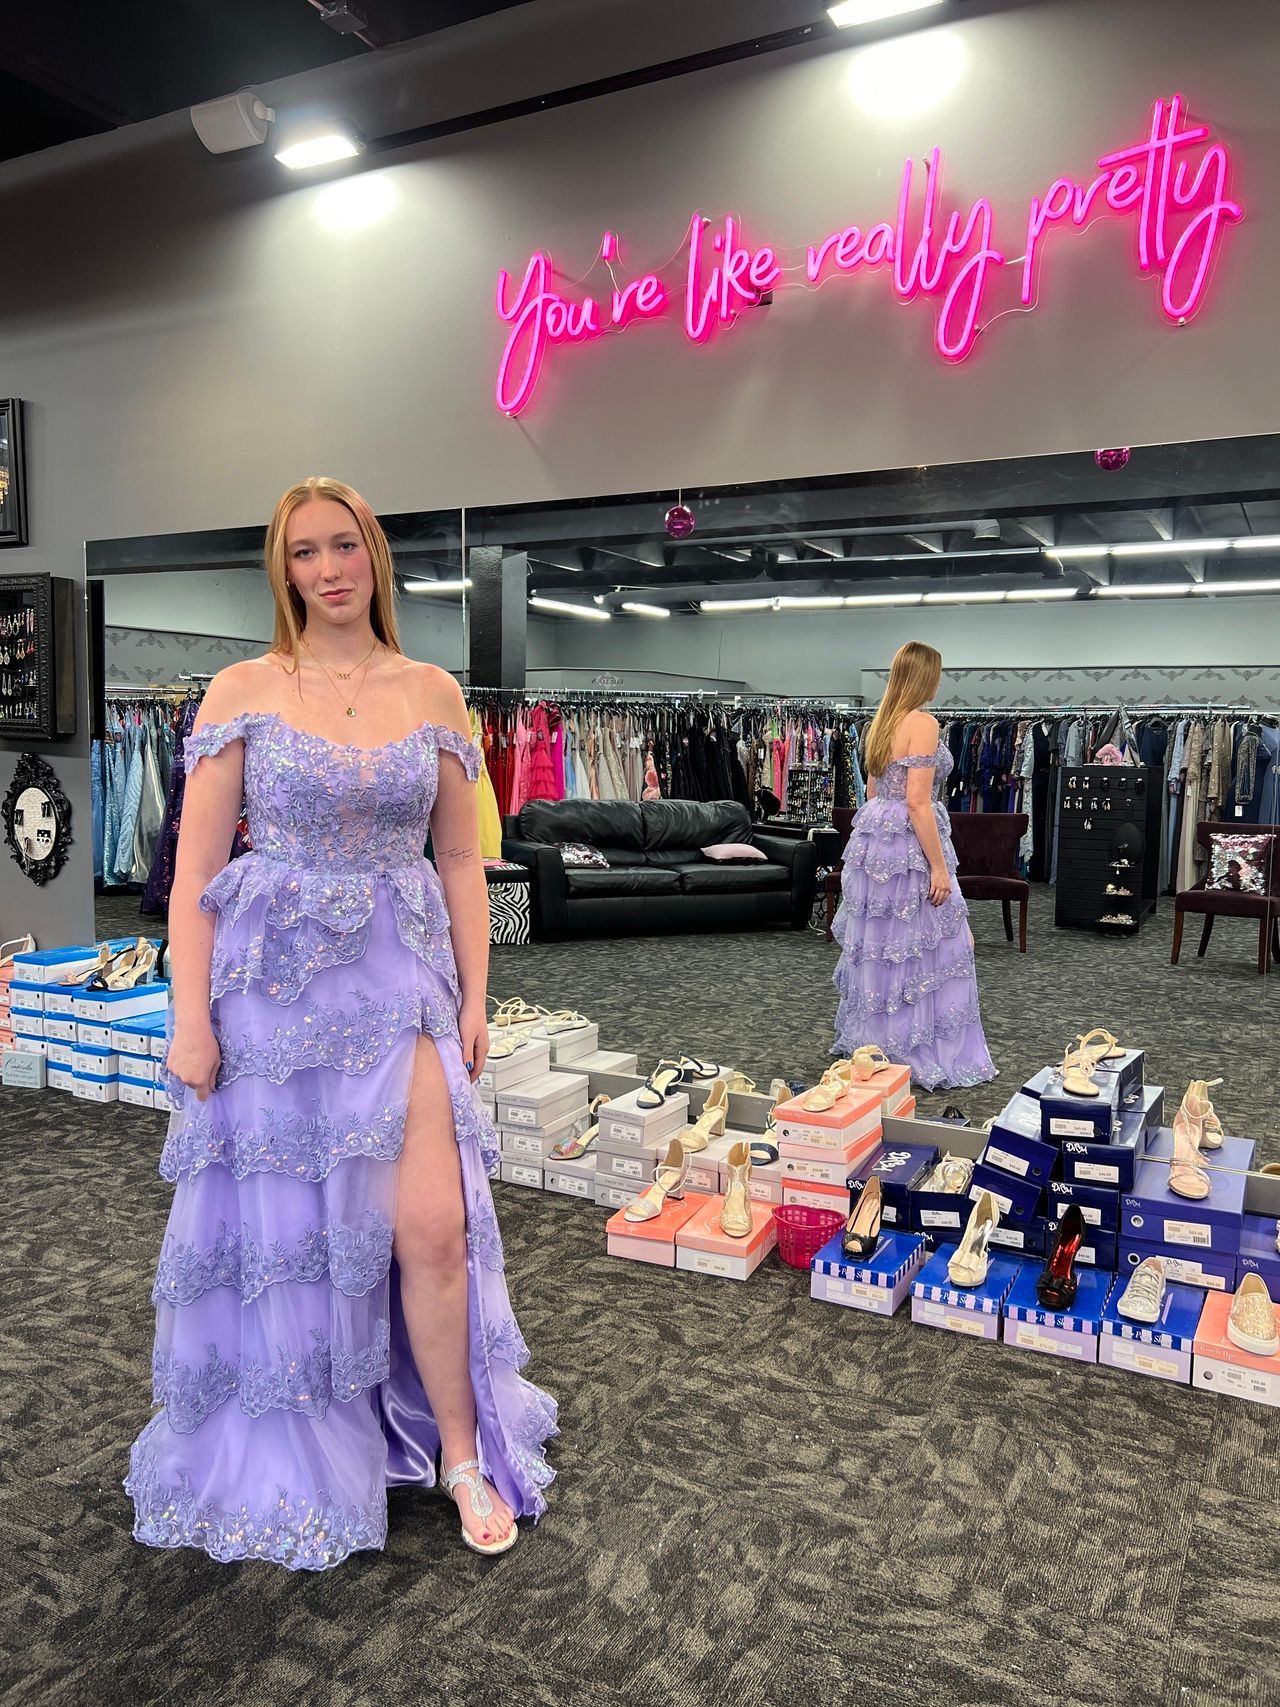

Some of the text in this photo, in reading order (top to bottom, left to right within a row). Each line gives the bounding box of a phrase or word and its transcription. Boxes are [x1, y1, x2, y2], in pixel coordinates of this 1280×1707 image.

[496, 95, 1242, 412] You're like really pretty
